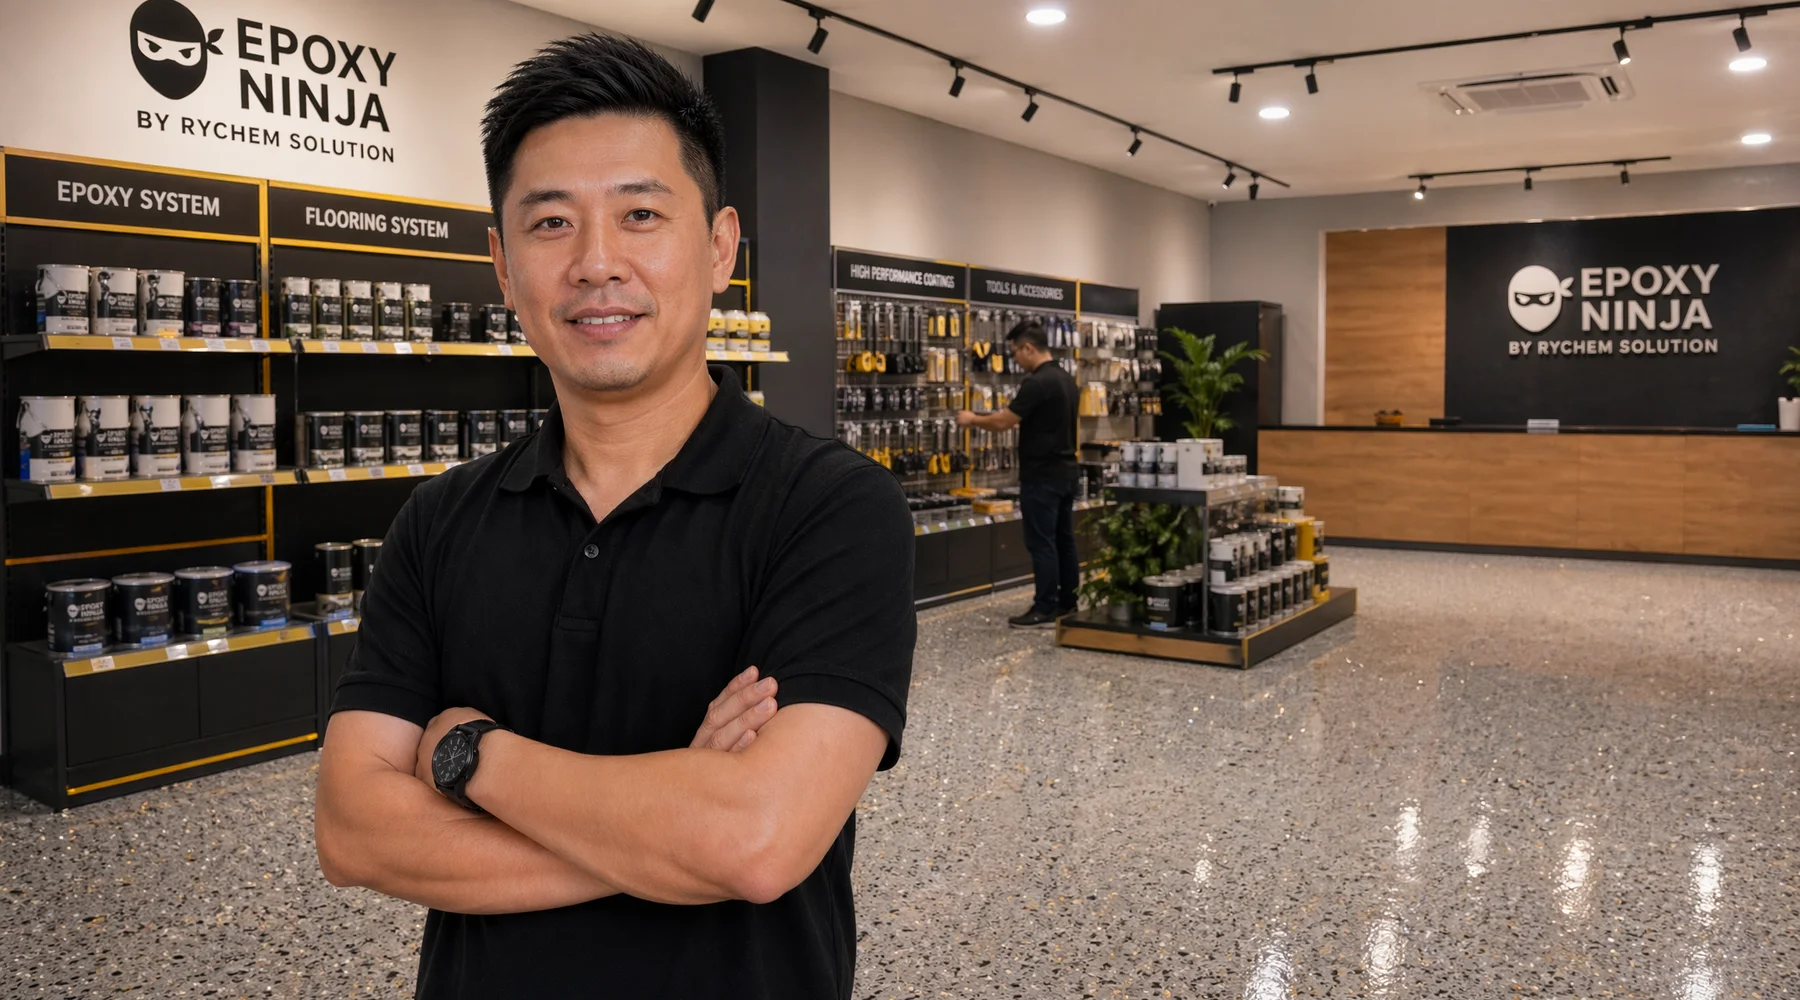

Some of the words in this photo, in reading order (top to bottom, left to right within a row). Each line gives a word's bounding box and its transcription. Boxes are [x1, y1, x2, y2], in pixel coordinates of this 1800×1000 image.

[237, 18, 397, 87] EPOXY
[240, 69, 390, 133] NINJA
[137, 110, 169, 131] BY
[181, 118, 280, 147] RYCHEM
[290, 133, 395, 163] SOLUTION
[57, 180, 134, 208] EPOXY
[140, 189, 220, 217] SYSTEM
[305, 207, 388, 233] FLOORING
[391, 216, 448, 239] SYSTEM
[850, 264, 870, 279] HIGH
[871, 266, 923, 285] PERFORMANCE
[923, 272, 955, 289] COATINGS
[985, 280, 1010, 295] TOOLS
[1011, 283, 1017, 296] &
[1018, 284, 1064, 300] ACCESSORIES
[1581, 263, 1720, 297] EPOXY
[1581, 299, 1713, 332] NINJA
[1508, 340, 1532, 355] BY
[1537, 339, 1613, 355] RYCHEM
[1619, 338, 1719, 354] SOLUTION
